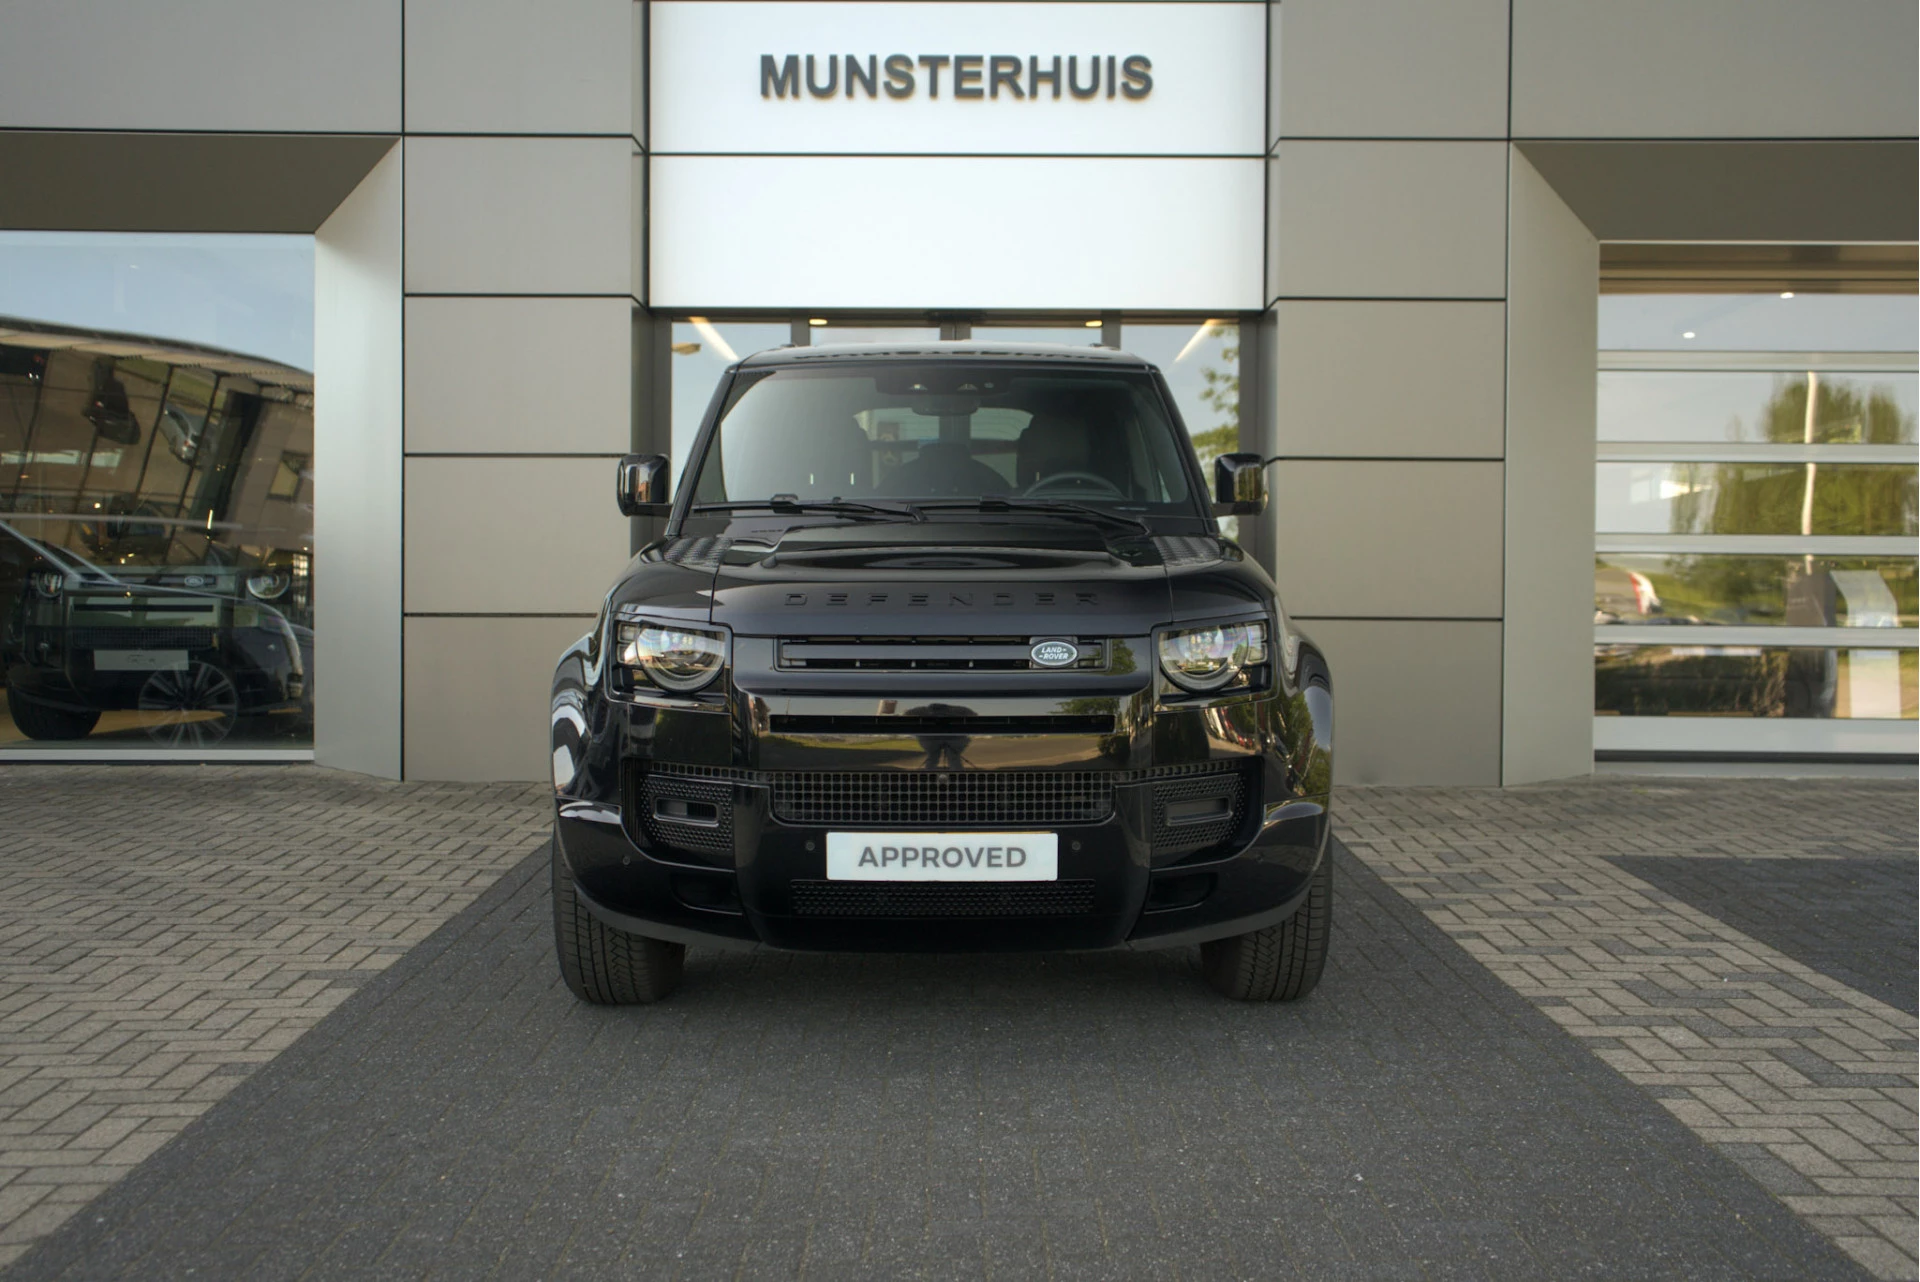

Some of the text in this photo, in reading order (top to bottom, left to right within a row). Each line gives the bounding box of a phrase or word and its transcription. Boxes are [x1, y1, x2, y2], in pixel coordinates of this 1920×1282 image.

[760, 54, 1154, 99] MUNSTERHUIS
[784, 592, 1099, 607] DEFENDER
[1043, 652, 1069, 660] ROVER
[858, 846, 1027, 868] APPROVED
